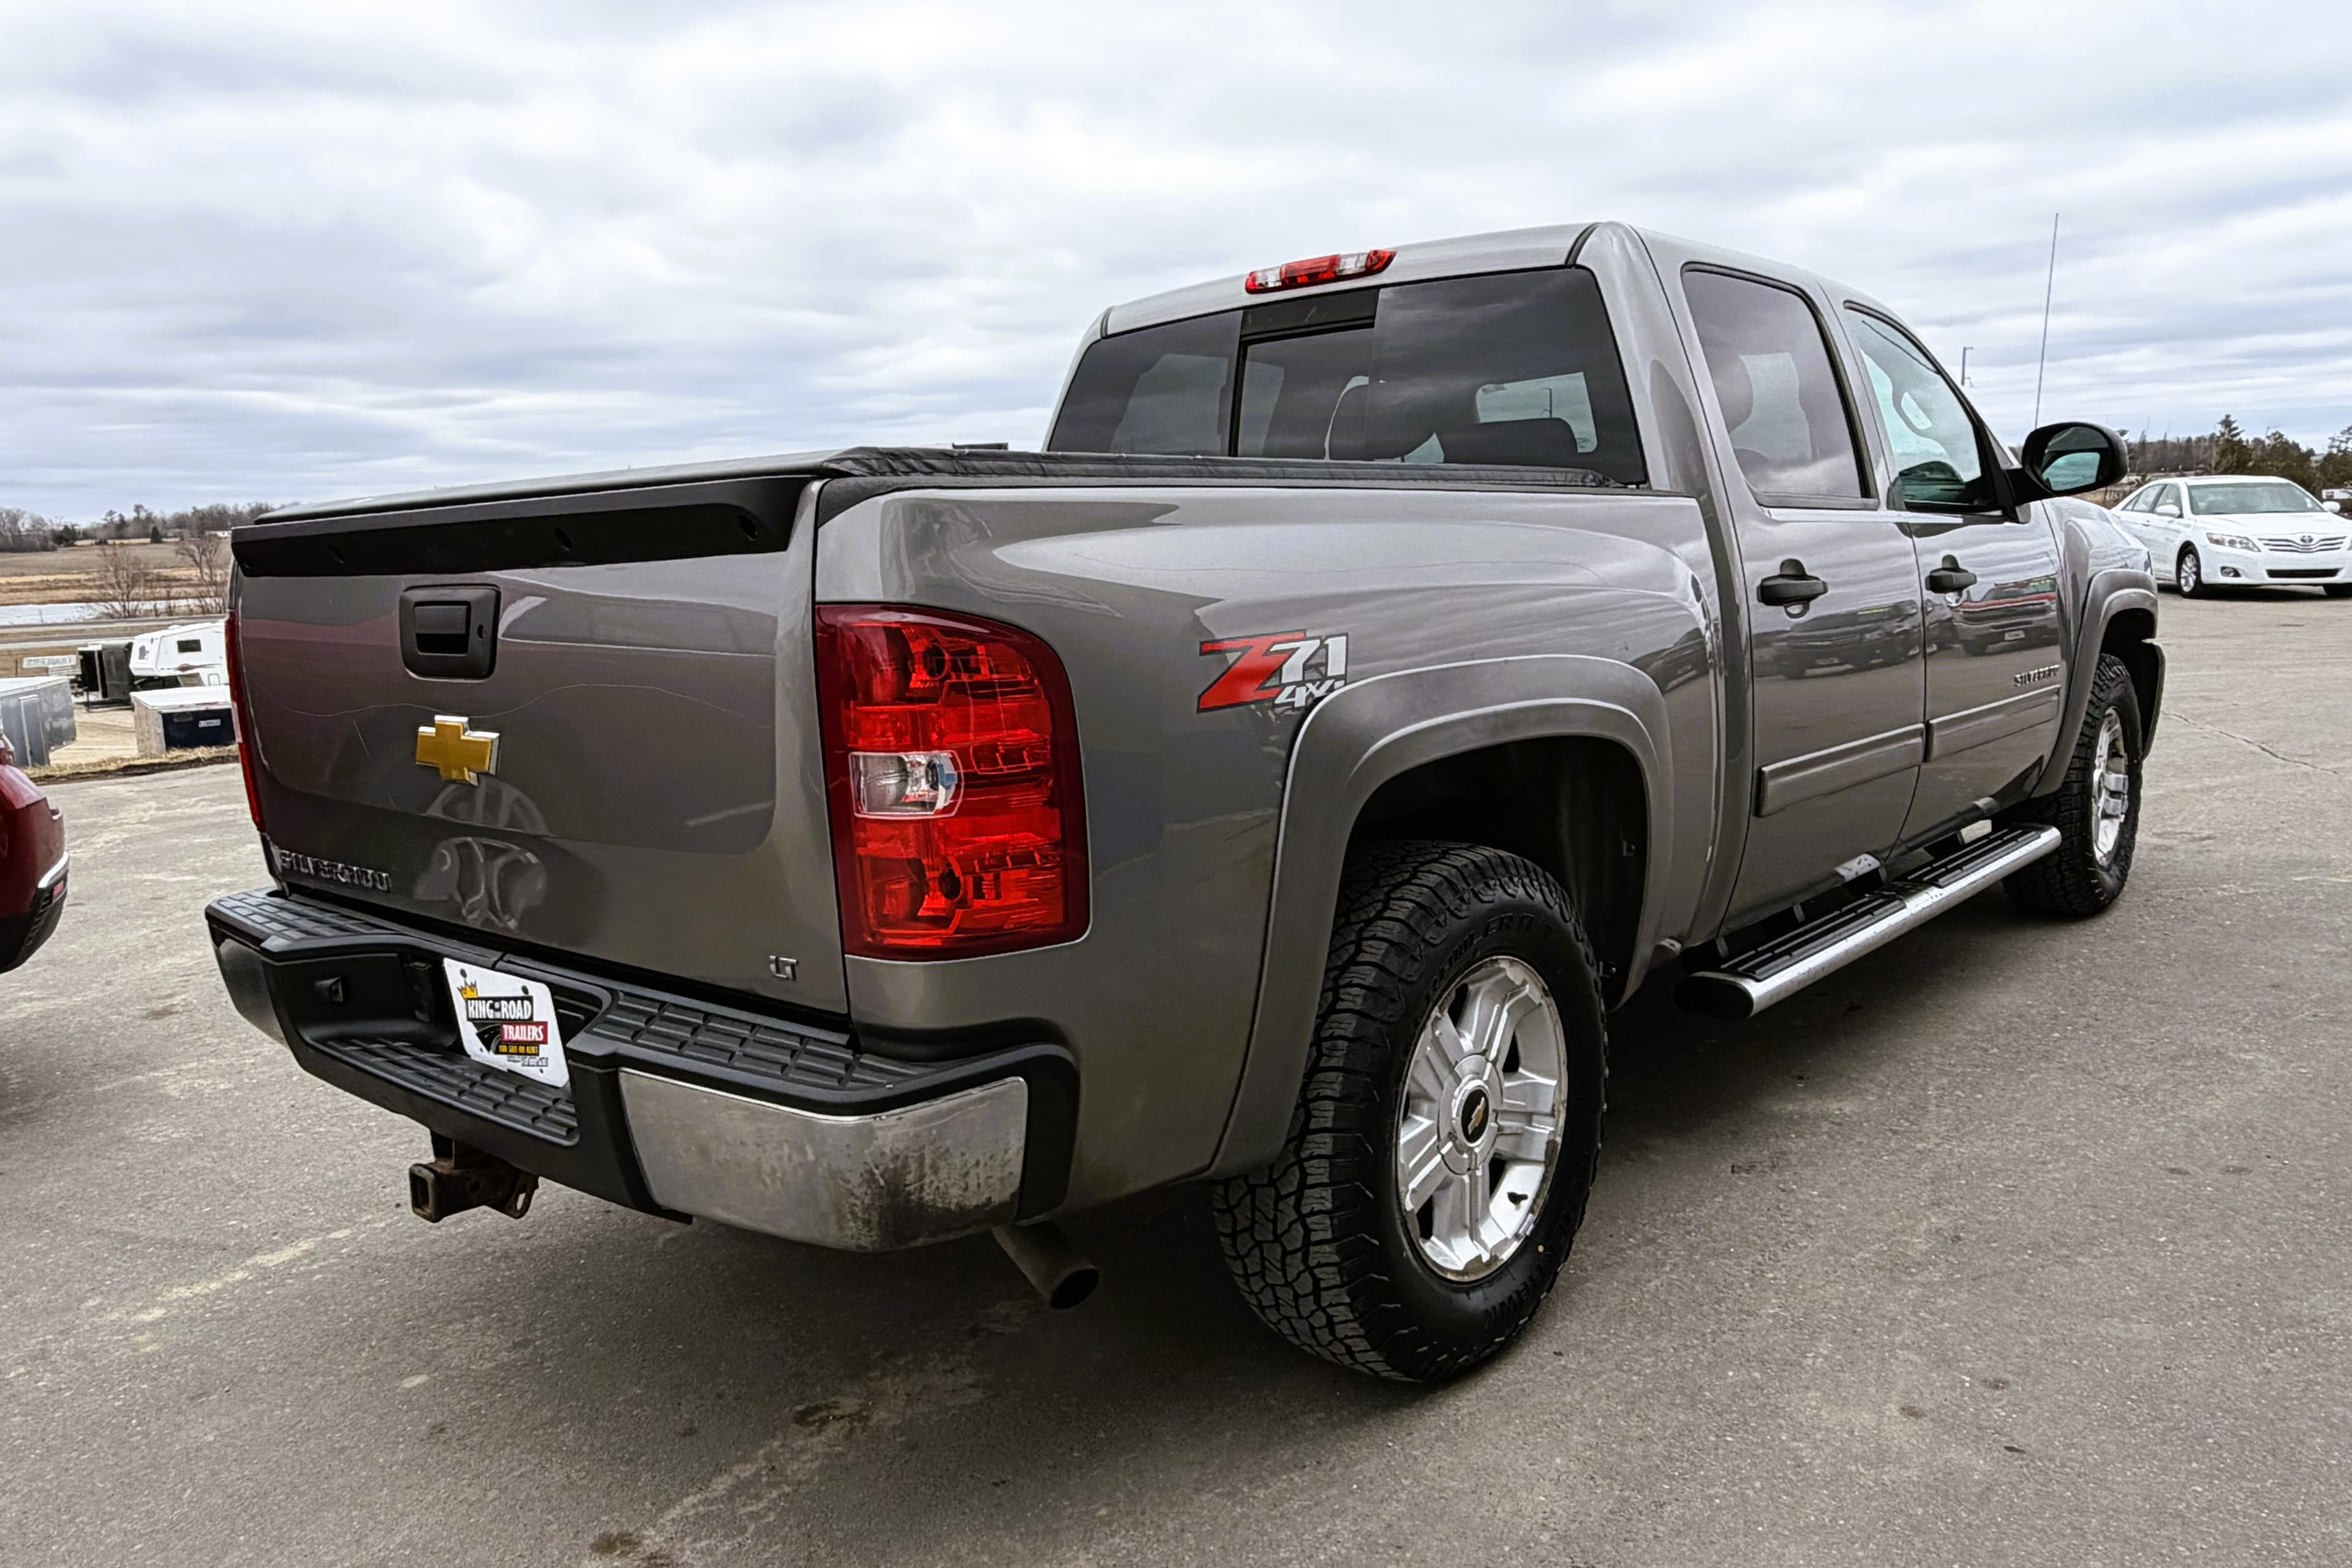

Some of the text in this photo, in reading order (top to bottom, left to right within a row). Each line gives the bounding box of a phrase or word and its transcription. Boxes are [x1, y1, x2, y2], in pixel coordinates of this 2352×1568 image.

[1196, 629, 1348, 714] Z71
[769, 955, 798, 981] LT
[467, 1000, 494, 1019] KING
[500, 1000, 532, 1019] ROAD
[502, 1024, 544, 1041] TRAILERS
